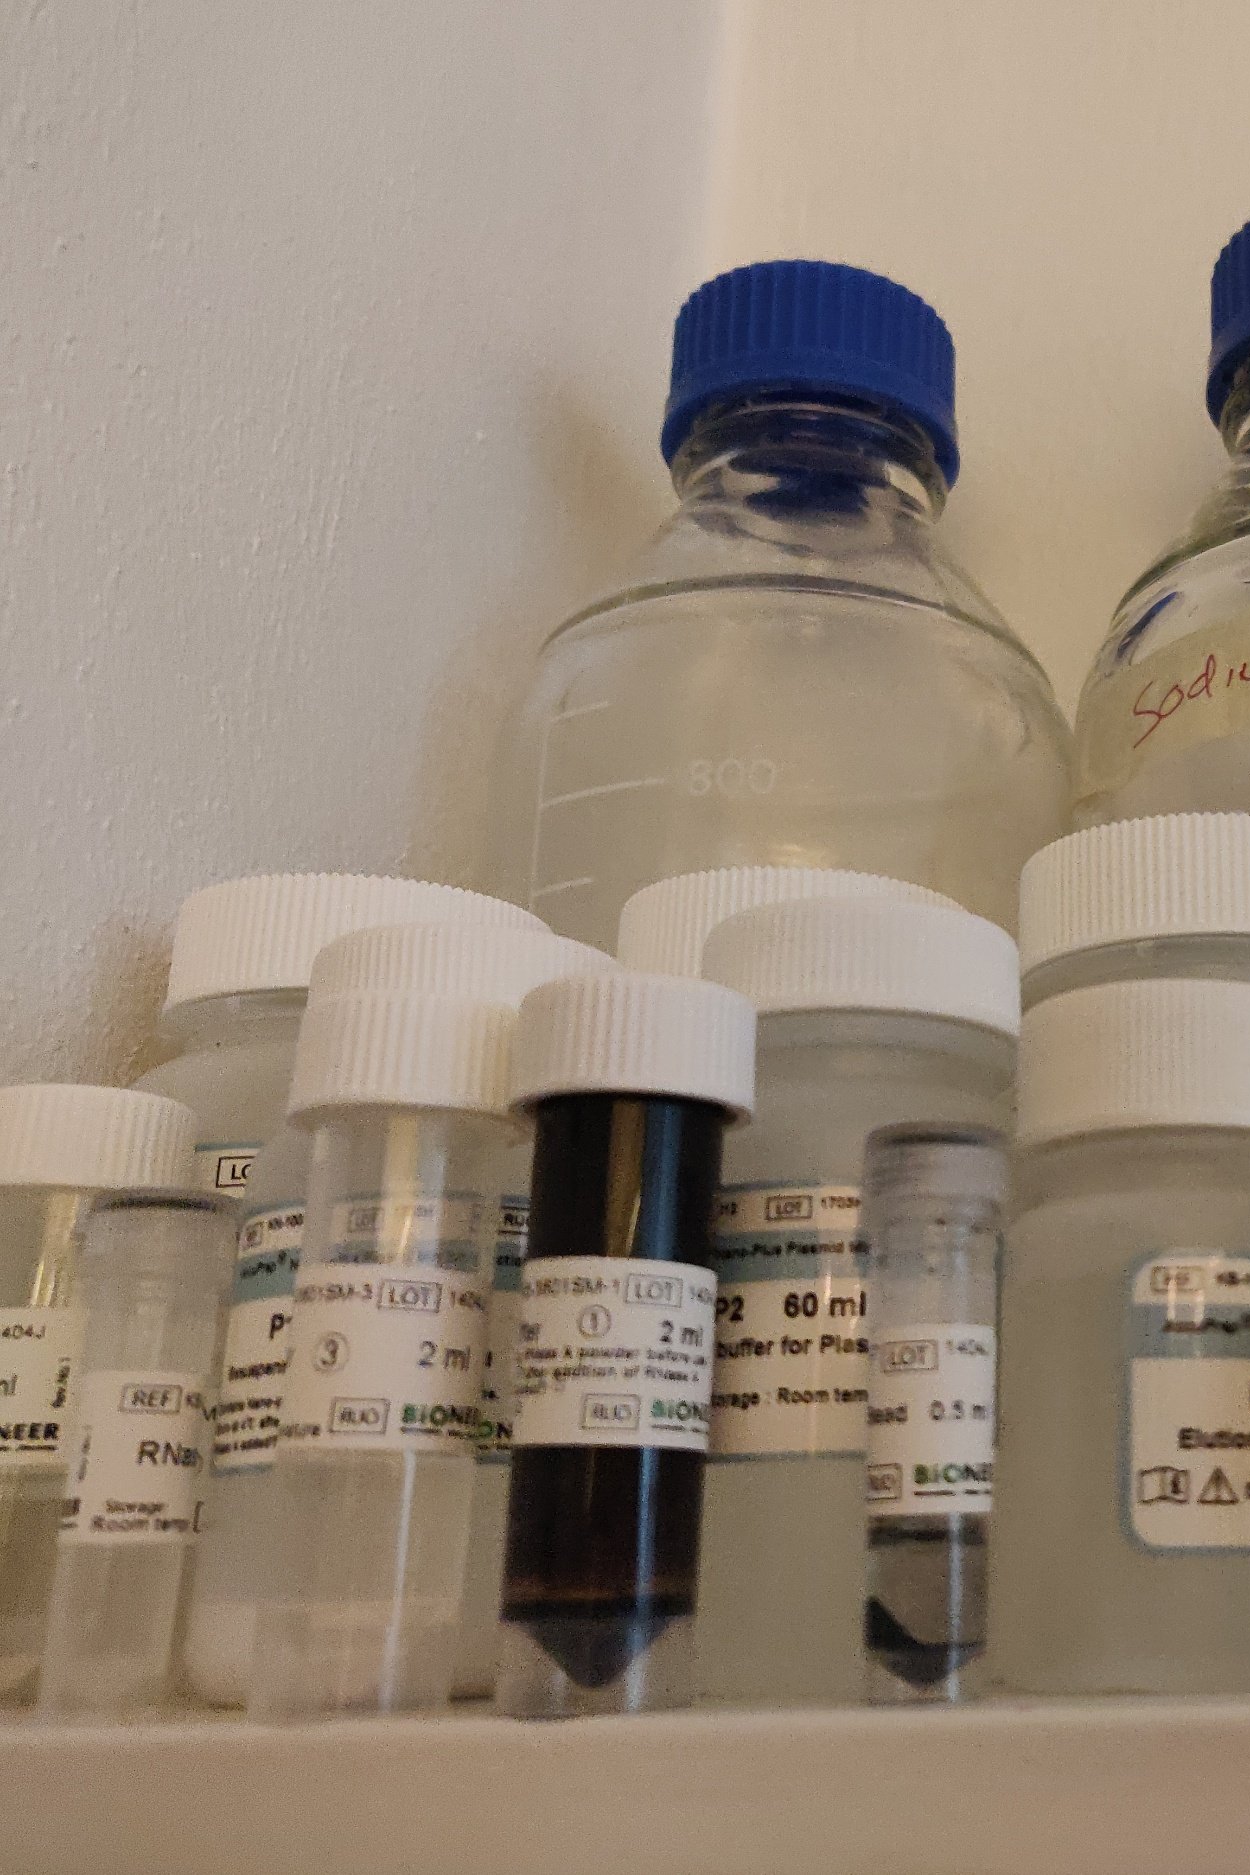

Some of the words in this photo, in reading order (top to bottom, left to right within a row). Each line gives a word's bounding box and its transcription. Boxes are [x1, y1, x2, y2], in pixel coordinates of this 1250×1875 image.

[688, 759, 777, 796] 800
[388, 1285, 431, 1307] LOT
[634, 1280, 674, 1302] LOT
[783, 1293, 819, 1318] 60
[829, 1291, 867, 1317] ml
[660, 1319, 674, 1343] 2
[680, 1325, 703, 1347] ml
[419, 1340, 437, 1366] 2
[444, 1346, 471, 1371] ml
[716, 1337, 774, 1359] buffer
[781, 1335, 813, 1356] for
[890, 1346, 926, 1367] LOT
[777, 1386, 829, 1405] Room
